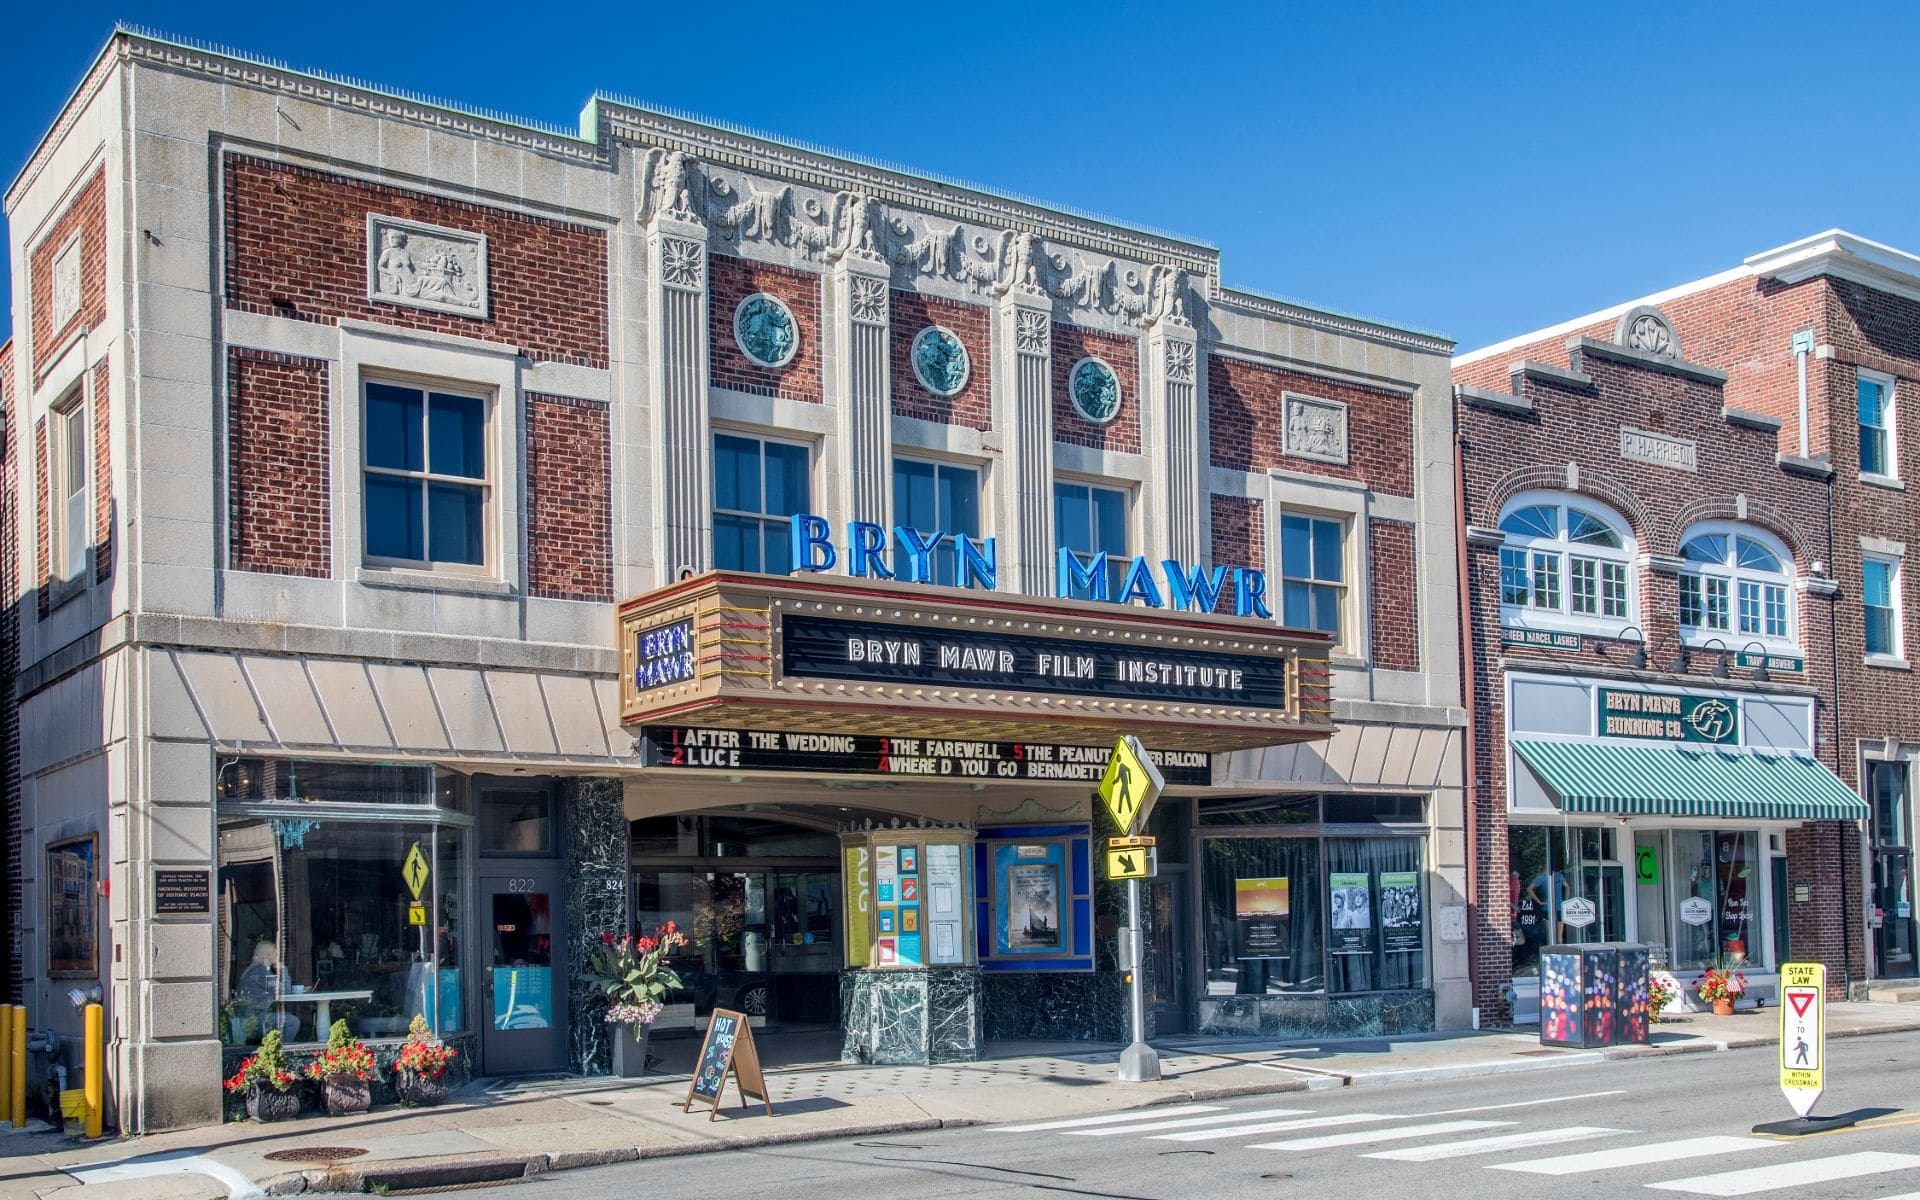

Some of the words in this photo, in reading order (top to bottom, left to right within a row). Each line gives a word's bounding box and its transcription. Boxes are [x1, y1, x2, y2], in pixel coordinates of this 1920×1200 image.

[1638, 436, 1695, 467] HARRISON
[791, 513, 996, 591] BRYN
[1058, 546, 1273, 619] MAWR
[1526, 631, 1552, 644] MARCEL
[1553, 634, 1578, 647] LASHES
[848, 638, 921, 665] BRYN
[941, 645, 1015, 673] MAWR
[1039, 654, 1094, 679] FILM
[1119, 660, 1243, 690] INSTITUTE
[1606, 691, 1640, 711] BRYN
[1642, 695, 1681, 714] MAWR
[1606, 716, 1664, 737] RUNNING
[1666, 720, 1685, 739] CO.
[684, 729, 740, 748] AFTER
[749, 732, 780, 750] THE
[786, 734, 856, 753] WEDDING
[879, 738, 889, 755] 3
[891, 739, 920, 755] THE
[926, 740, 1001, 760] FAREWELL
[671, 748, 683, 765] 2
[688, 748, 740, 767] LUCE
[1013, 743, 1024, 760] 5
[1025, 745, 1053, 761] THE
[1059, 748, 1112, 763] PEANUT
[1164, 752, 1207, 767] FALCON
[878, 756, 889, 773] 4
[889, 757, 937, 773] WHERE
[941, 758, 951, 774] D
[960, 760, 989, 776] YOU
[997, 761, 1018, 777] GO
[1027, 762, 1108, 780] BERNADETT
[509, 879, 535, 893] 822
[606, 879, 623, 890] 824
[1521, 914, 1536, 925] 1991
[1788, 967, 1815, 975] STATE
[1792, 976, 1810, 985] LAW
[714, 1017, 733, 1034] HOT
[1796, 1026, 1805, 1034] TO
[1784, 1078, 1818, 1086] CROSSWALK
